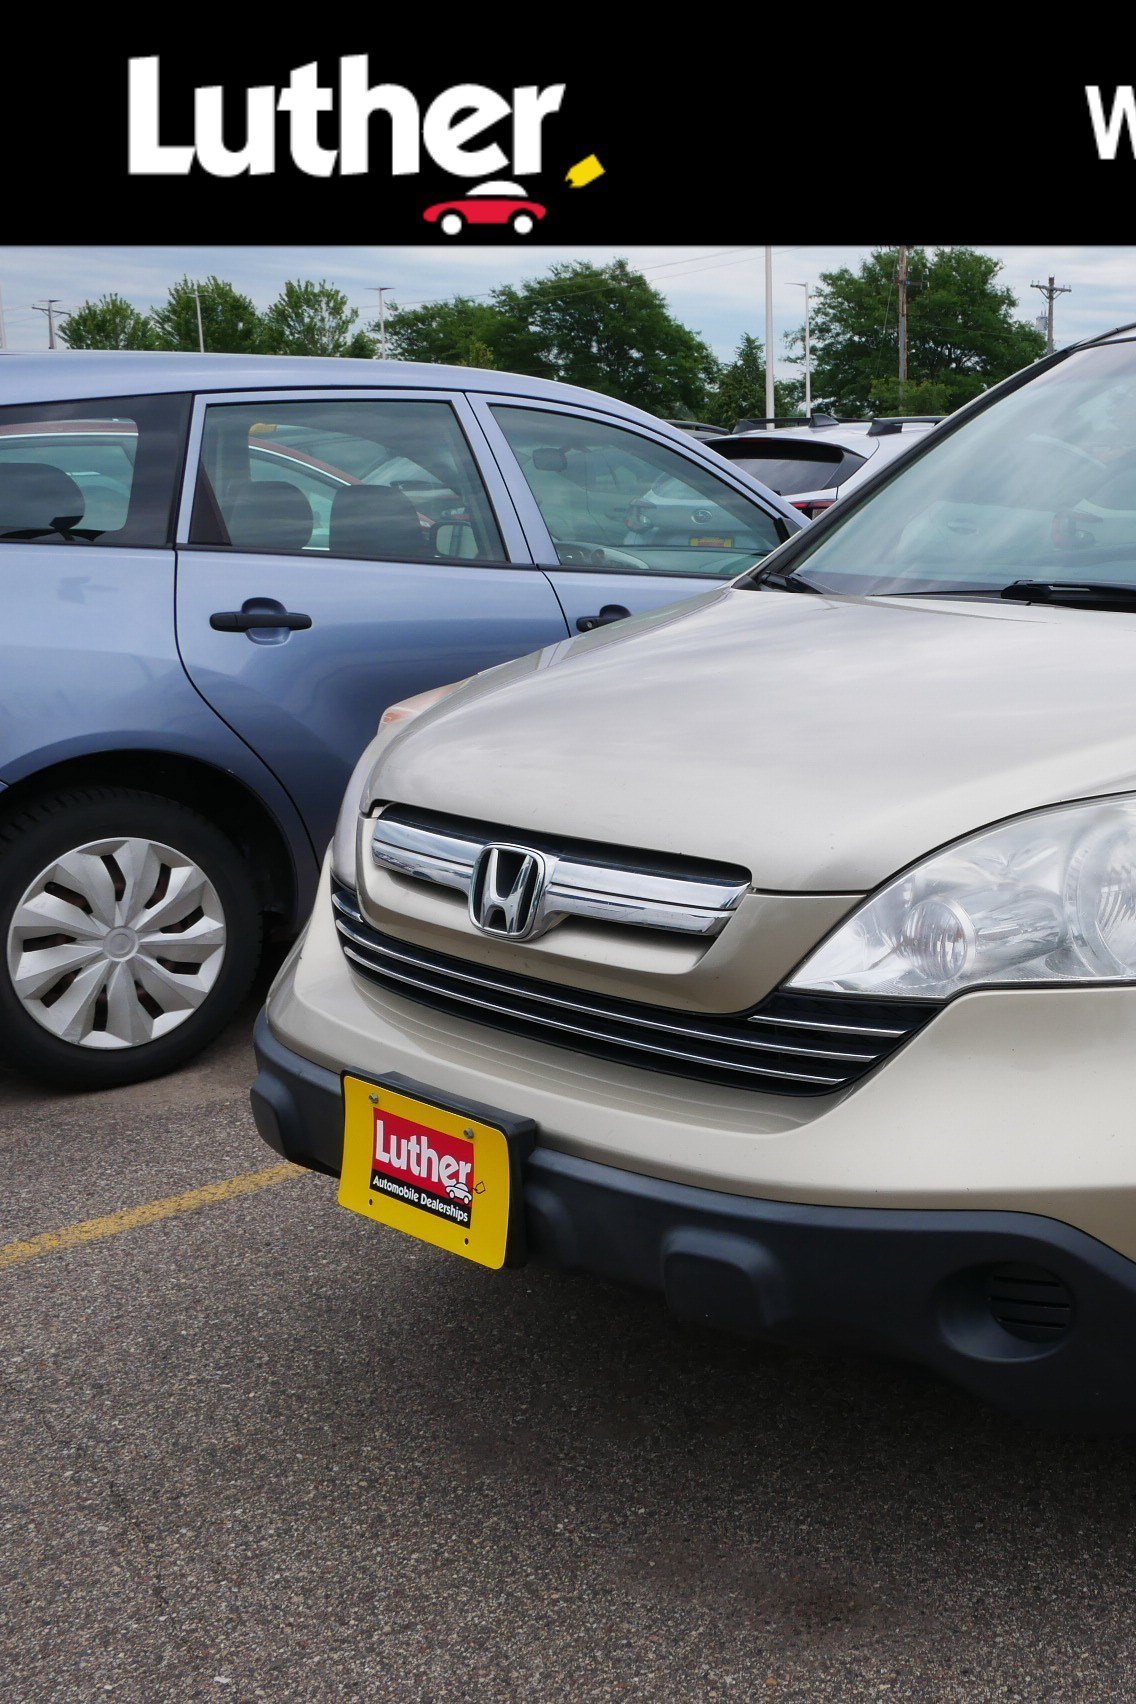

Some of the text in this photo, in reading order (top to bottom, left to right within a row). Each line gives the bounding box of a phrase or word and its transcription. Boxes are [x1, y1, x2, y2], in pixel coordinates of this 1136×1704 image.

[375, 1119, 472, 1187] Luther
[372, 1175, 468, 1222] Automobile Dealerships
